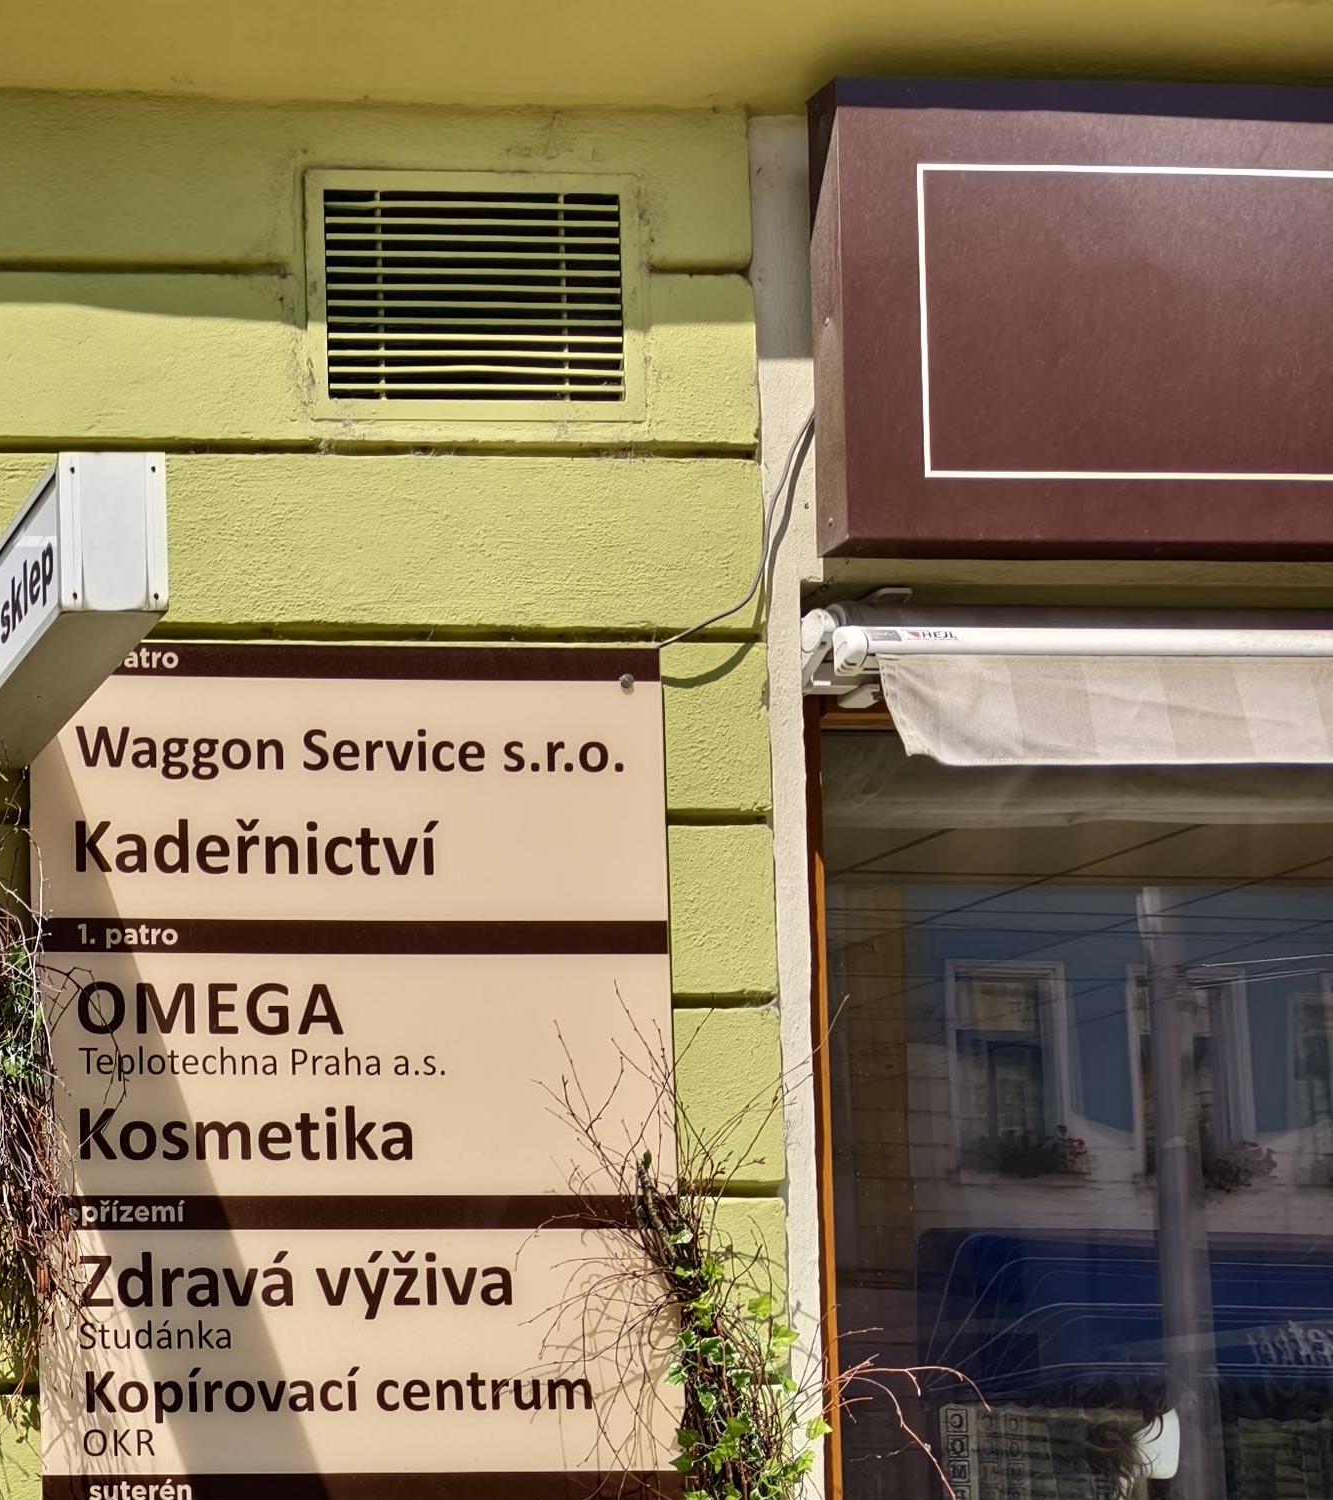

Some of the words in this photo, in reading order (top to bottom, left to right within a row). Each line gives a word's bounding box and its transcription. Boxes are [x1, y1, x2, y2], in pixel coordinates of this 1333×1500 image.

[0, 542, 55, 645] sklep
[120, 646, 180, 669] atro
[75, 725, 284, 780] Waggon
[303, 728, 486, 773] Service
[503, 739, 626, 775] s.r.o.
[74, 818, 439, 877] Kadeřnictví
[77, 923, 96, 946] 1.
[106, 924, 179, 949] patro
[77, 981, 345, 1036] OMEGA
[79, 1045, 280, 1081] Teplotechna
[291, 1046, 384, 1078] Praha
[393, 1054, 448, 1078] a.s.
[78, 1105, 415, 1164] Kosmetika
[81, 1199, 186, 1227] přízemí
[79, 1250, 294, 1308] Zdravá
[315, 1247, 515, 1321] výživa
[79, 1319, 233, 1350] Studánka
[84, 1366, 359, 1425] Kopírovací
[376, 1370, 594, 1413] centrum
[82, 1428, 156, 1458] OKR
